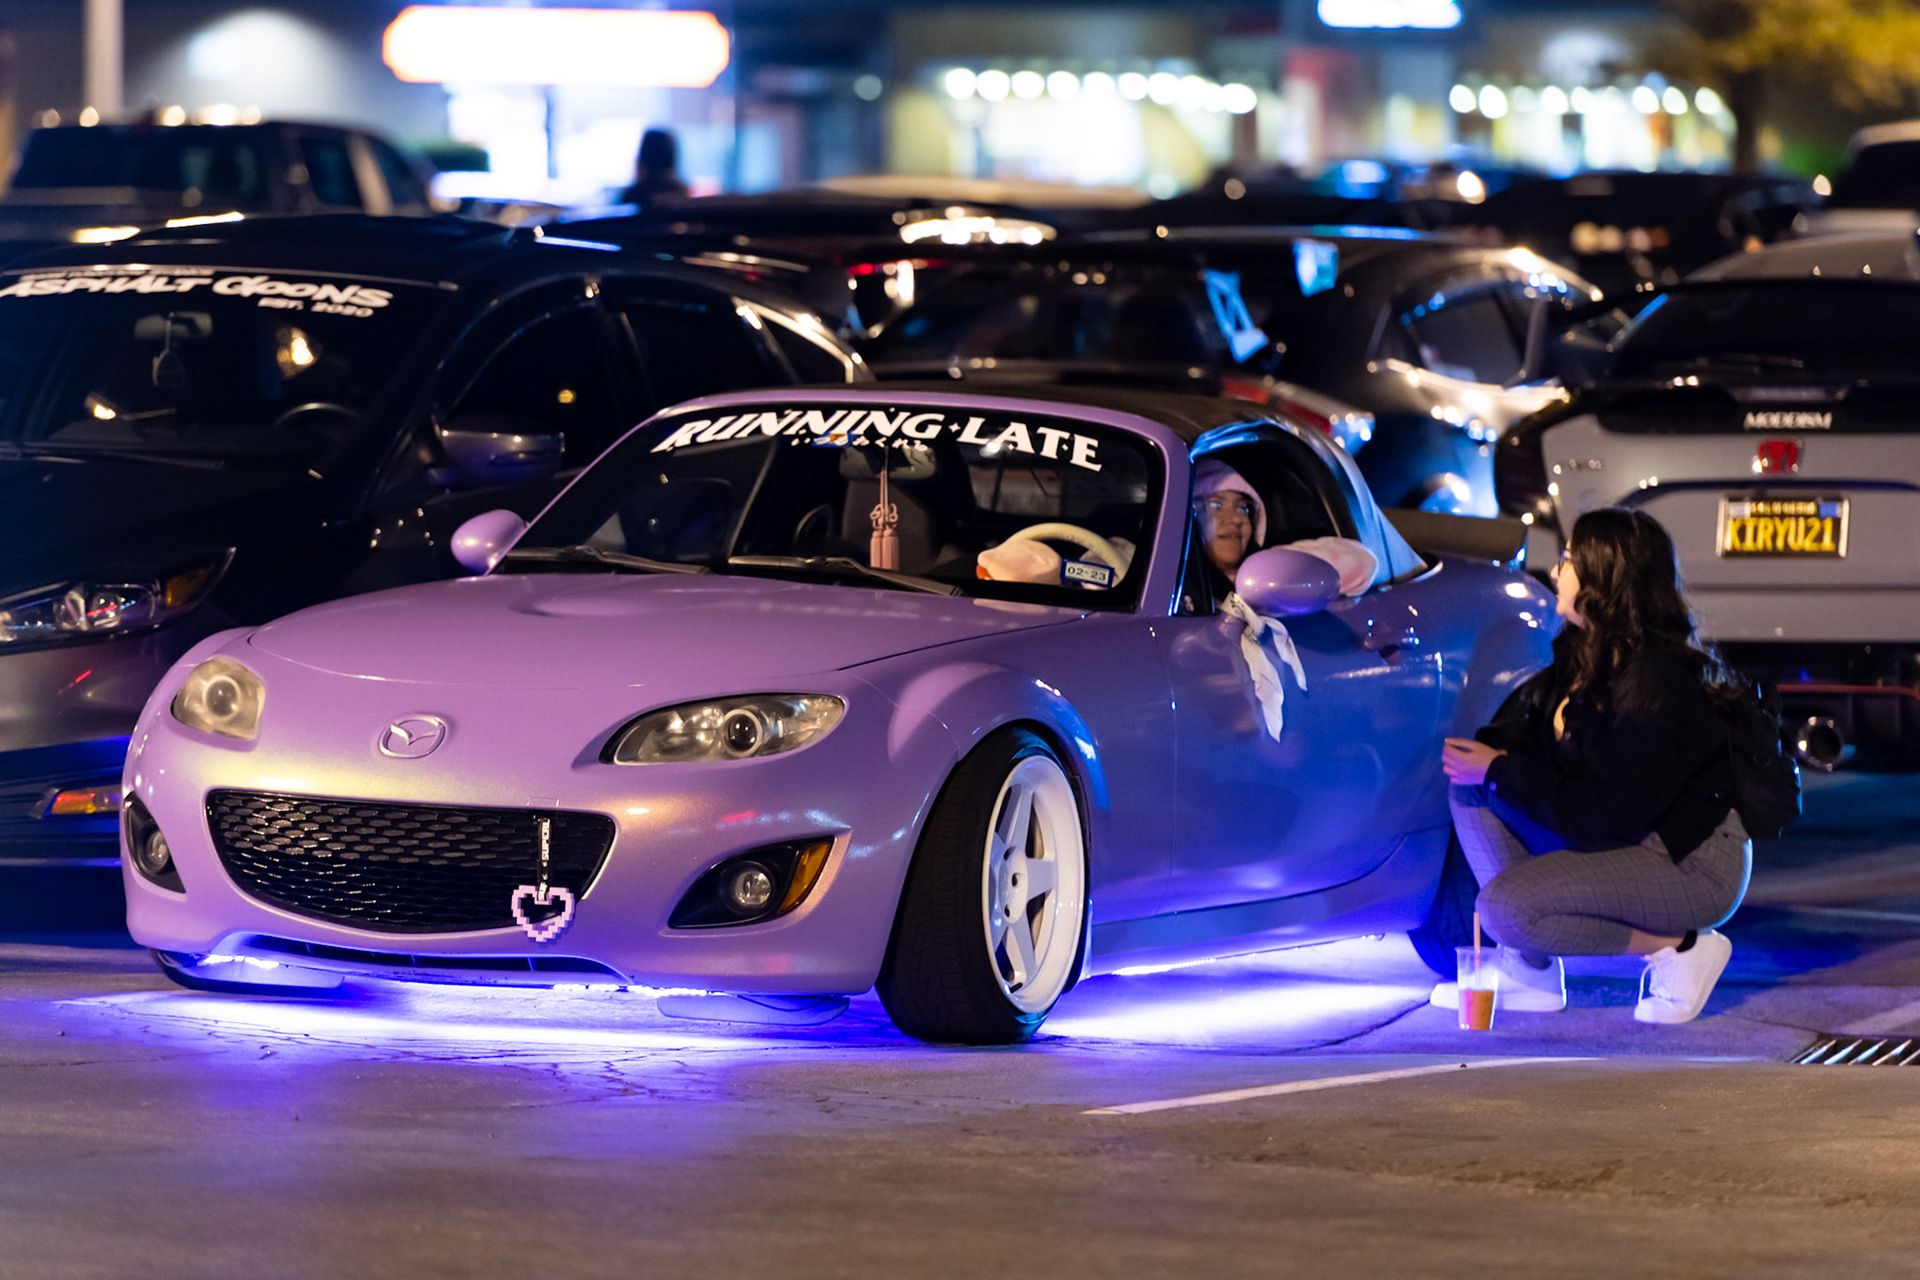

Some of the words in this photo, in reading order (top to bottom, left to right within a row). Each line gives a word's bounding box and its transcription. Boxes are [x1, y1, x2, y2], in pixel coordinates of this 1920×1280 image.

[650, 409, 946, 453] RUNNING
[956, 416, 1102, 472] LATE
[1725, 517, 1835, 551] KIRYU21
